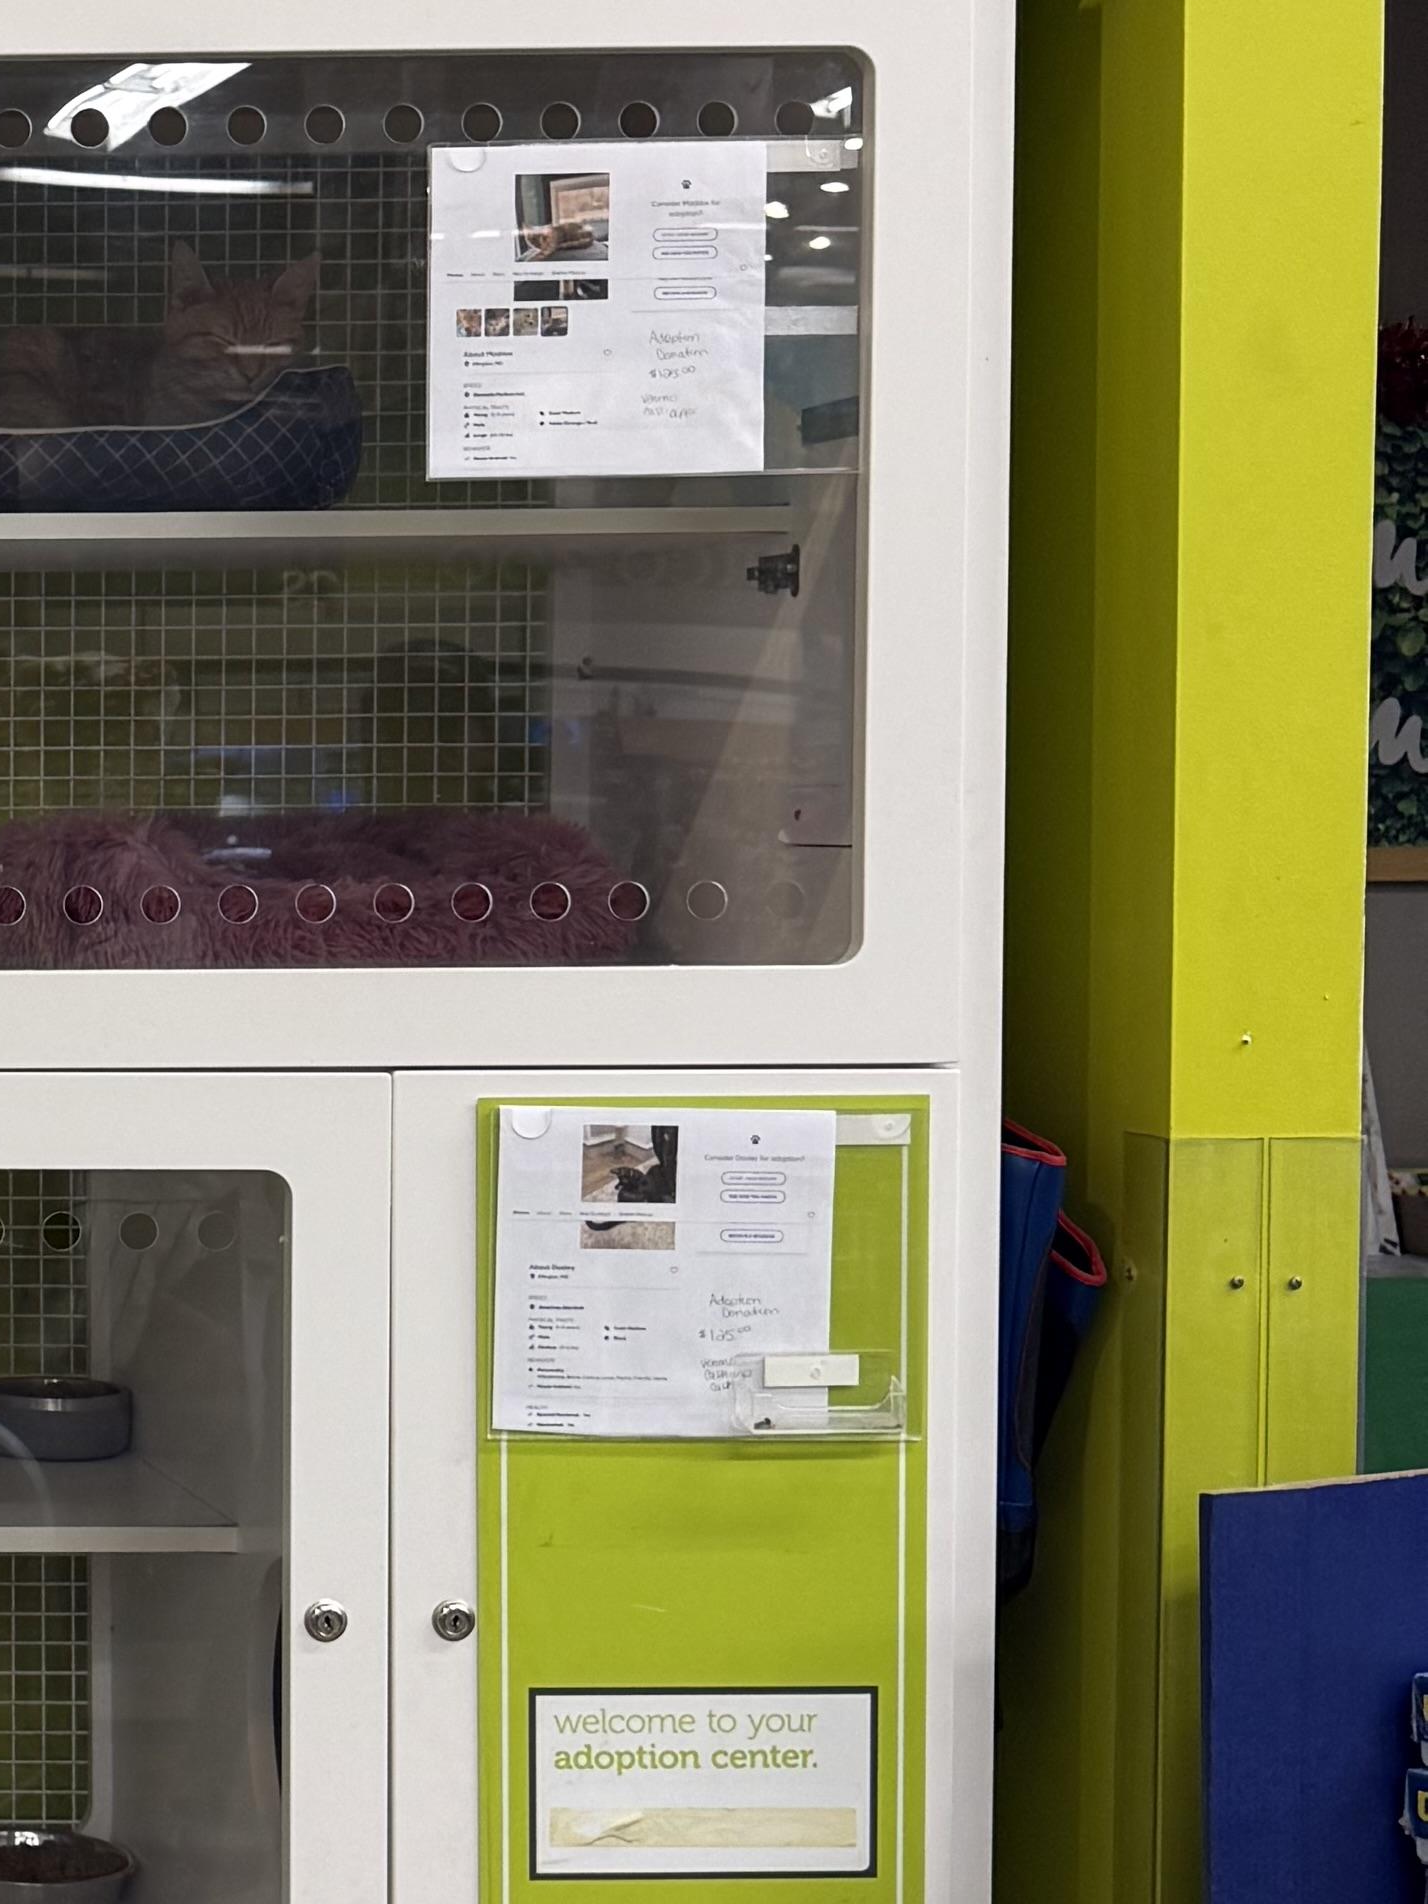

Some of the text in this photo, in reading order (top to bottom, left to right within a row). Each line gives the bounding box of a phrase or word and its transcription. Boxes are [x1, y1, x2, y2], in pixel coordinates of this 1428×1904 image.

[553, 1708, 818, 1741] welcome to your
[553, 1744, 818, 1776] adoption center.
